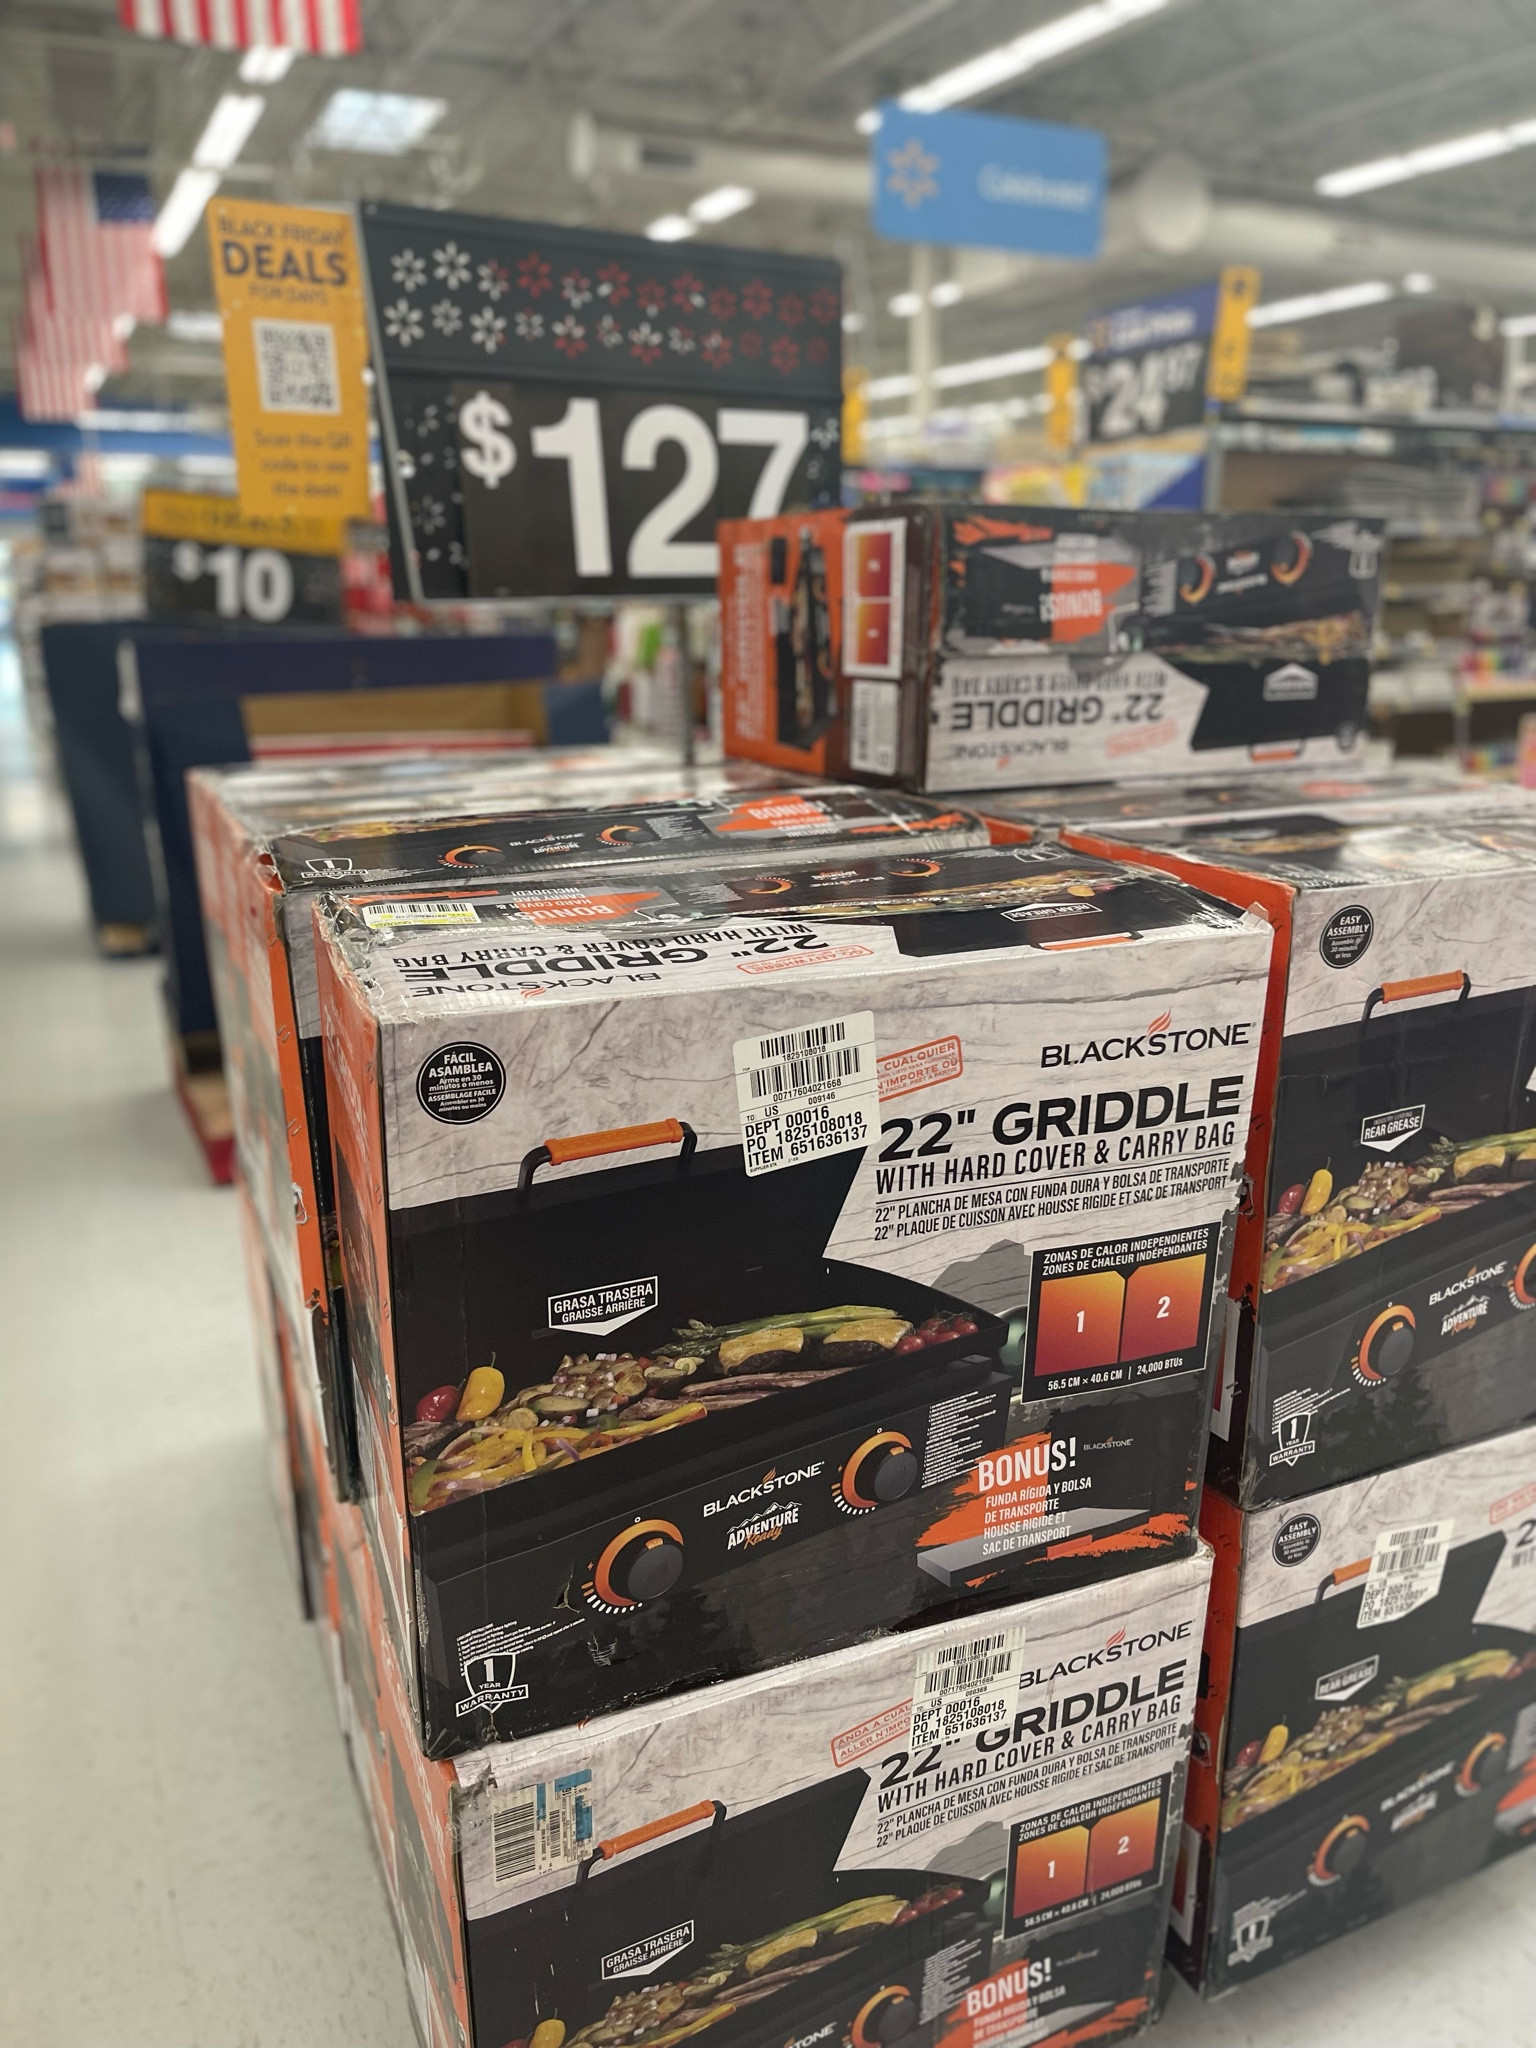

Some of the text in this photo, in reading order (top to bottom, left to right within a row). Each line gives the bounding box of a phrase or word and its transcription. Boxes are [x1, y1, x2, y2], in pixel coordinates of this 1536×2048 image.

[222, 240, 347, 286] DEALS
[952, 697, 1103, 730] GRIDDLE
[510, 833, 585, 847] BLACKSTONE
[501, 904, 615, 921] BONUS!
[1340, 915, 1361, 925] EASY
[1327, 924, 1370, 936] ASSEMBLY
[392, 924, 813, 968] WITH HARD COVER & CARRY BAG
[400, 934, 829, 983] 22" GRIDDLE
[409, 972, 662, 998] BLACKSTONE
[444, 1052, 476, 1064] FÁCIL
[782, 1045, 826, 1061] 1825108018
[884, 1042, 955, 1071] CUALQUIER
[1041, 1022, 1251, 1068] BLACKSTONE
[429, 1062, 493, 1078] ASAMBLEA
[440, 1077, 459, 1085] Arme
[428, 1091, 473, 1102] ASSEMBLAGE
[429, 1082, 460, 1091] minutos
[773, 1079, 842, 1102] 00717604021668
[765, 1092, 835, 1117] US 009146
[745, 1106, 829, 1138] DEPT 00016
[747, 1111, 862, 1152] PO 1825108018
[878, 1075, 1244, 1163] 22" GRIDDLE
[1365, 1124, 1386, 1140] REAR
[1387, 1116, 1420, 1134] GREASE
[748, 1124, 868, 1167] ITEM 651636137
[876, 1121, 1235, 1194] WITH HARD COVER & CARRY BAG
[875, 1157, 1230, 1223] 22" PLANCHA DE MESA CON FUNDA DURA BOLSA DE TRANSPORTE
[874, 1175, 1228, 1241] 22" PLAQUE DE CUISSON AVEC HOUSSE RIGIDE ET SAC DE TRANSPORT
[1042, 1239, 1208, 1276] ZONES DE CHALEUR INDÉPENDANTES
[1043, 1228, 1209, 1264] ZONAS DE CALOR INDEPENDIENTES
[1428, 1261, 1505, 1306] BLACKSTONE
[554, 1283, 653, 1314] GRASA TRASERA
[562, 1298, 646, 1323] GRAISSE ARRIÈRE
[1156, 1296, 1171, 1319] 2
[1077, 1310, 1085, 1333] 1
[1441, 1302, 1488, 1336] ADVENTURE
[1047, 1368, 1123, 1391] 56.5 CM 40.6 CM
[1137, 1357, 1183, 1376] 24,000 BTUs
[1290, 1417, 1298, 1439] 1
[1084, 1439, 1131, 1451] BLACKSTONE
[1272, 1443, 1313, 1462] WARRANTY
[978, 1436, 1076, 1492] BONUS!
[703, 1463, 822, 1518] BLACKSTONE
[985, 1476, 1092, 1509] FUNDA RÍGIDA Y BOLSA
[985, 1498, 1060, 1524] DE TRANSPORTE
[727, 1506, 799, 1550] ADVENTURE
[743, 1525, 783, 1550] Ready
[983, 1511, 1067, 1539] HOUSSE RIGIDE ET
[1278, 1527, 1317, 1543] ASSEMBLY
[1289, 1521, 1308, 1532] EASY
[982, 1525, 1071, 1555] SAC DE TRANSPORT
[1019, 1621, 1192, 1690] BLACKSTONE
[483, 1658, 494, 1682] 1
[479, 1682, 501, 1690] YEAR
[460, 1689, 525, 1712] WARRANTY
[914, 1697, 980, 1724] DEPT 00016
[976, 1659, 1187, 1753] GRIDDLE
[912, 1709, 1007, 1746] ITEM 651636137
[913, 1700, 1005, 1735] PO 1825108018
[839, 1727, 869, 1745] ANDA
[840, 1736, 872, 1758] ALLER
[878, 1694, 1181, 1814] WITH HARD COVER & CARRY BAG
[966, 1957, 1052, 2017] BONUS!
